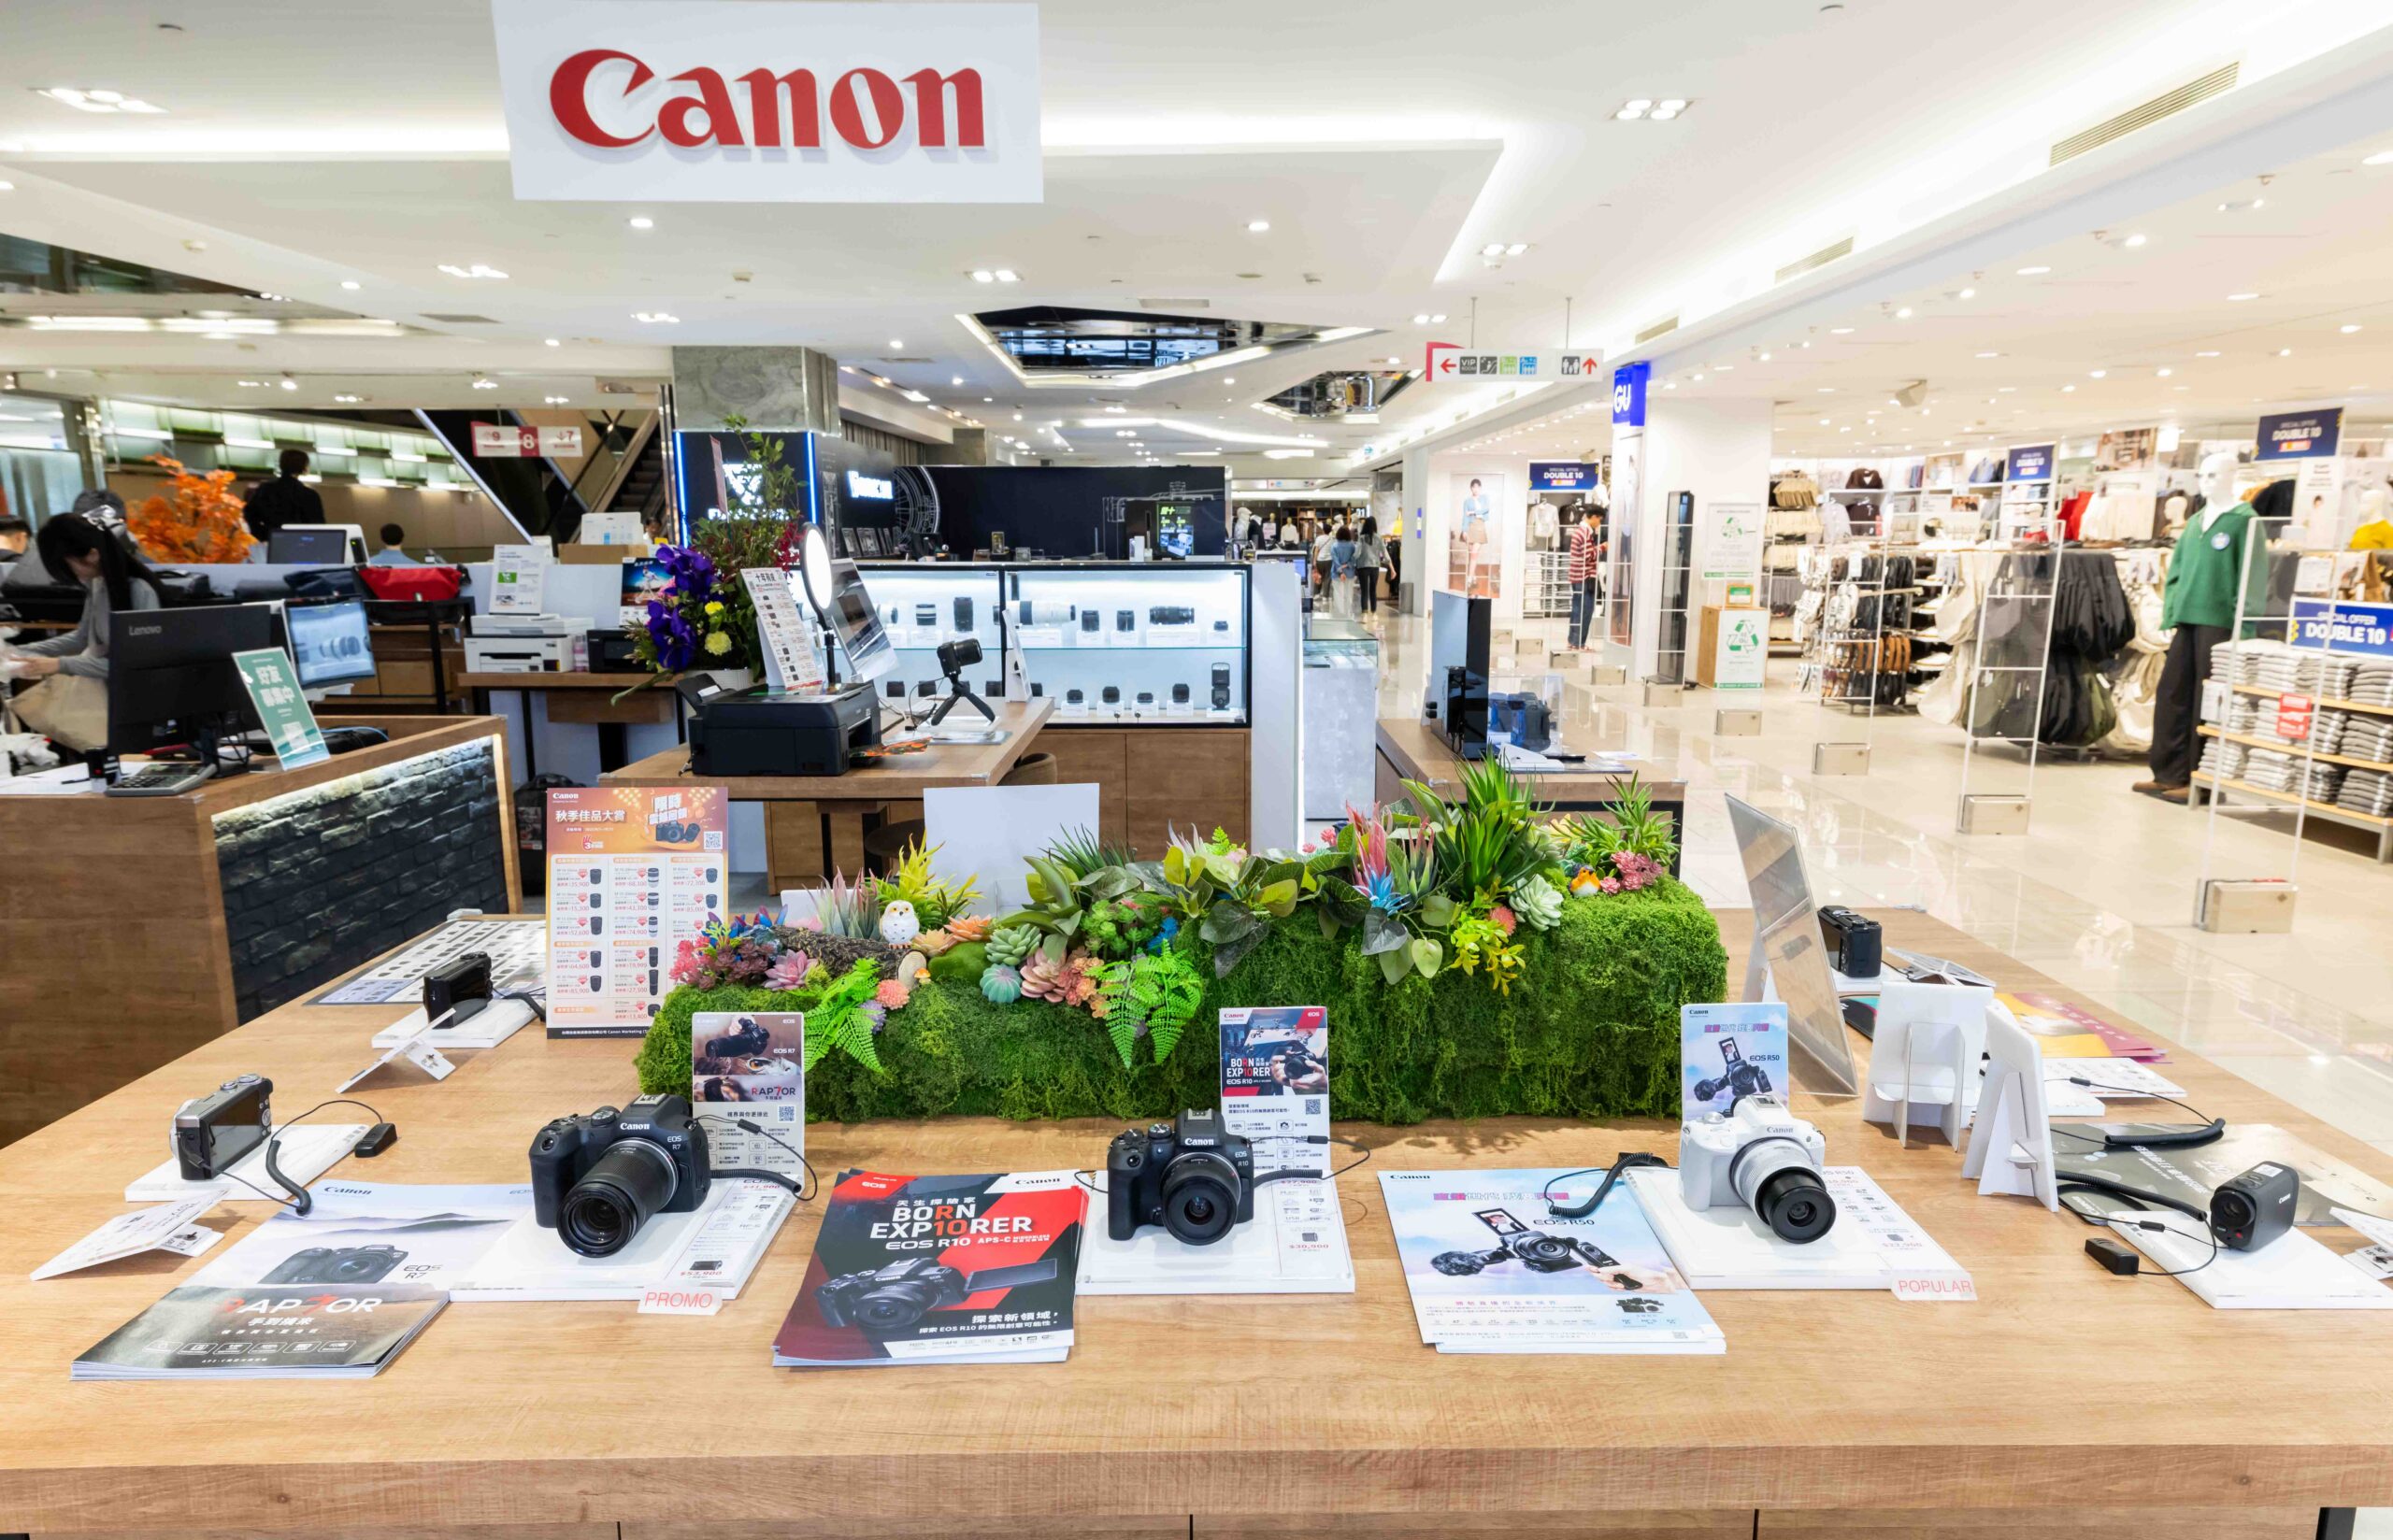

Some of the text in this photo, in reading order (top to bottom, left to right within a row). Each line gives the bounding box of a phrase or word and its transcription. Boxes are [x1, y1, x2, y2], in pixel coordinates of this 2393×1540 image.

[550, 49, 985, 149] Canon
[1613, 384, 1631, 413] GU
[492, 431, 501, 441] 9
[523, 434, 535, 449] 8
[566, 430, 574, 441] 7
[2367, 627, 2386, 645] 10
[555, 809, 626, 823] 秋季佳品大賞
[1230, 1058, 1254, 1067] BORN
[1226, 1067, 1271, 1077] EXP10RER
[1184, 1137, 1215, 1146] Canon
[324, 1186, 372, 1195] Canon
[896, 1196, 976, 1206] 天生探險家
[892, 1204, 976, 1222] BORN
[869, 1217, 1032, 1239] EXP10RER
[885, 1239, 934, 1250] EOS
[938, 1237, 971, 1248] R10
[977, 1235, 1011, 1245] APS-C
[1898, 1279, 1973, 1293] POPULAR
[645, 1291, 713, 1308] PROMO
